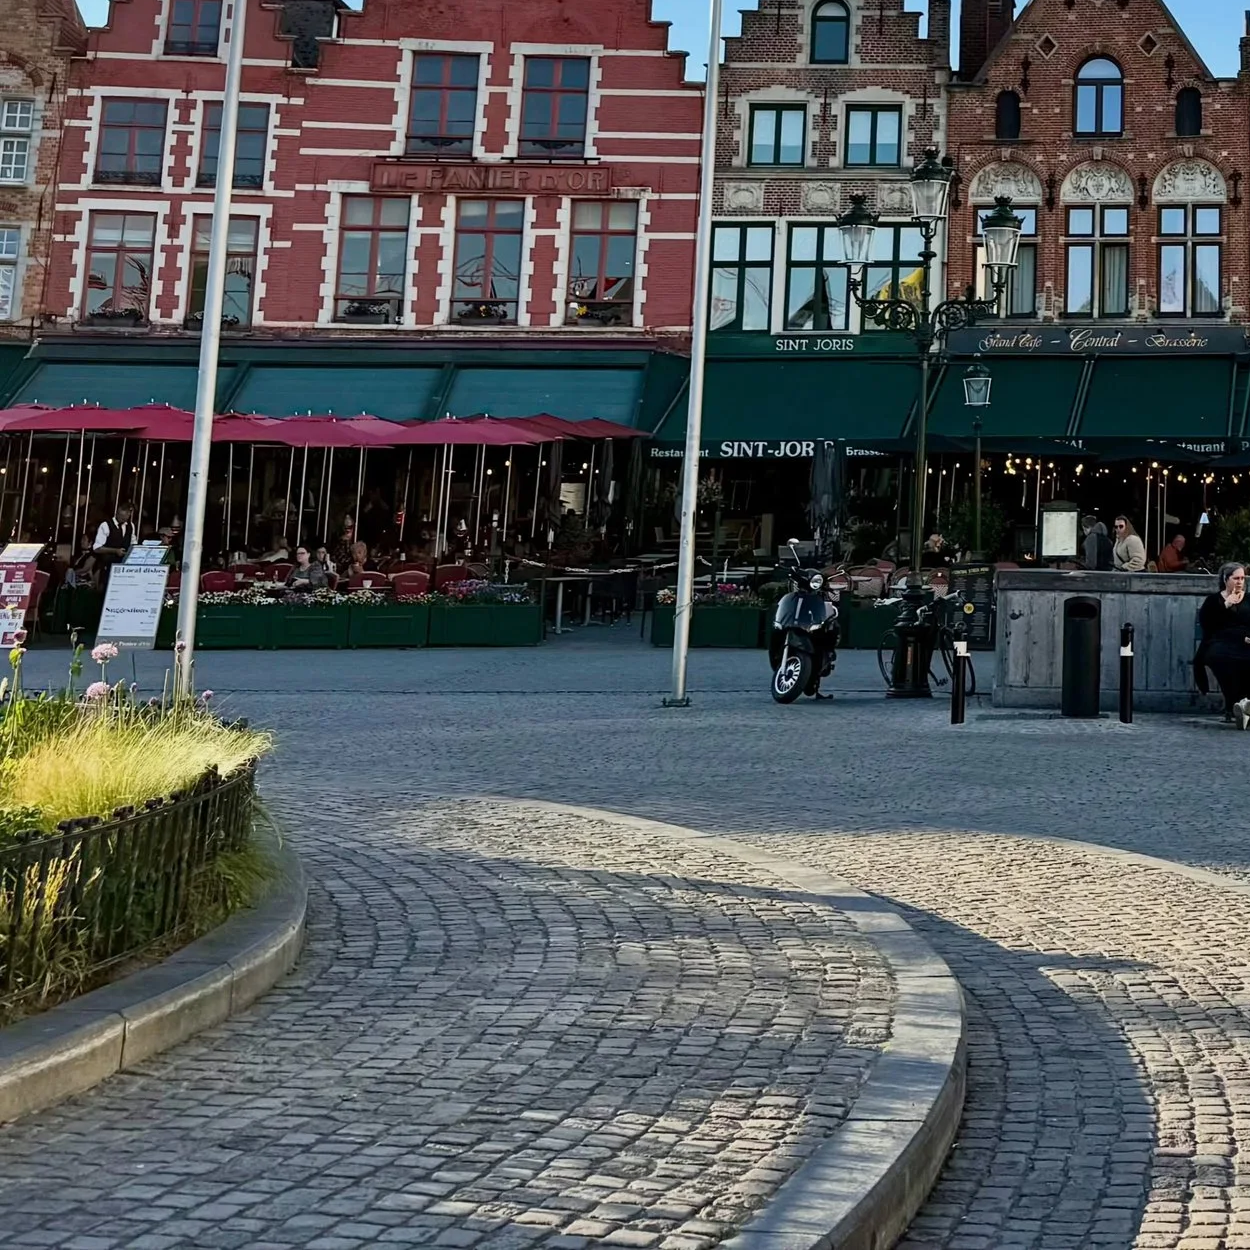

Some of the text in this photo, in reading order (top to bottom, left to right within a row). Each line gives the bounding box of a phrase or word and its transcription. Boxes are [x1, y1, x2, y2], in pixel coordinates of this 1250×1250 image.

[382, 170, 418, 188] LE
[425, 167, 530, 190] PANIER
[776, 338, 854, 351] SINT JORIS
[979, 334, 1018, 352] Grand
[1070, 328, 1121, 351] Central
[1145, 333, 1208, 348] Brasserie
[121, 566, 142, 574] Local
